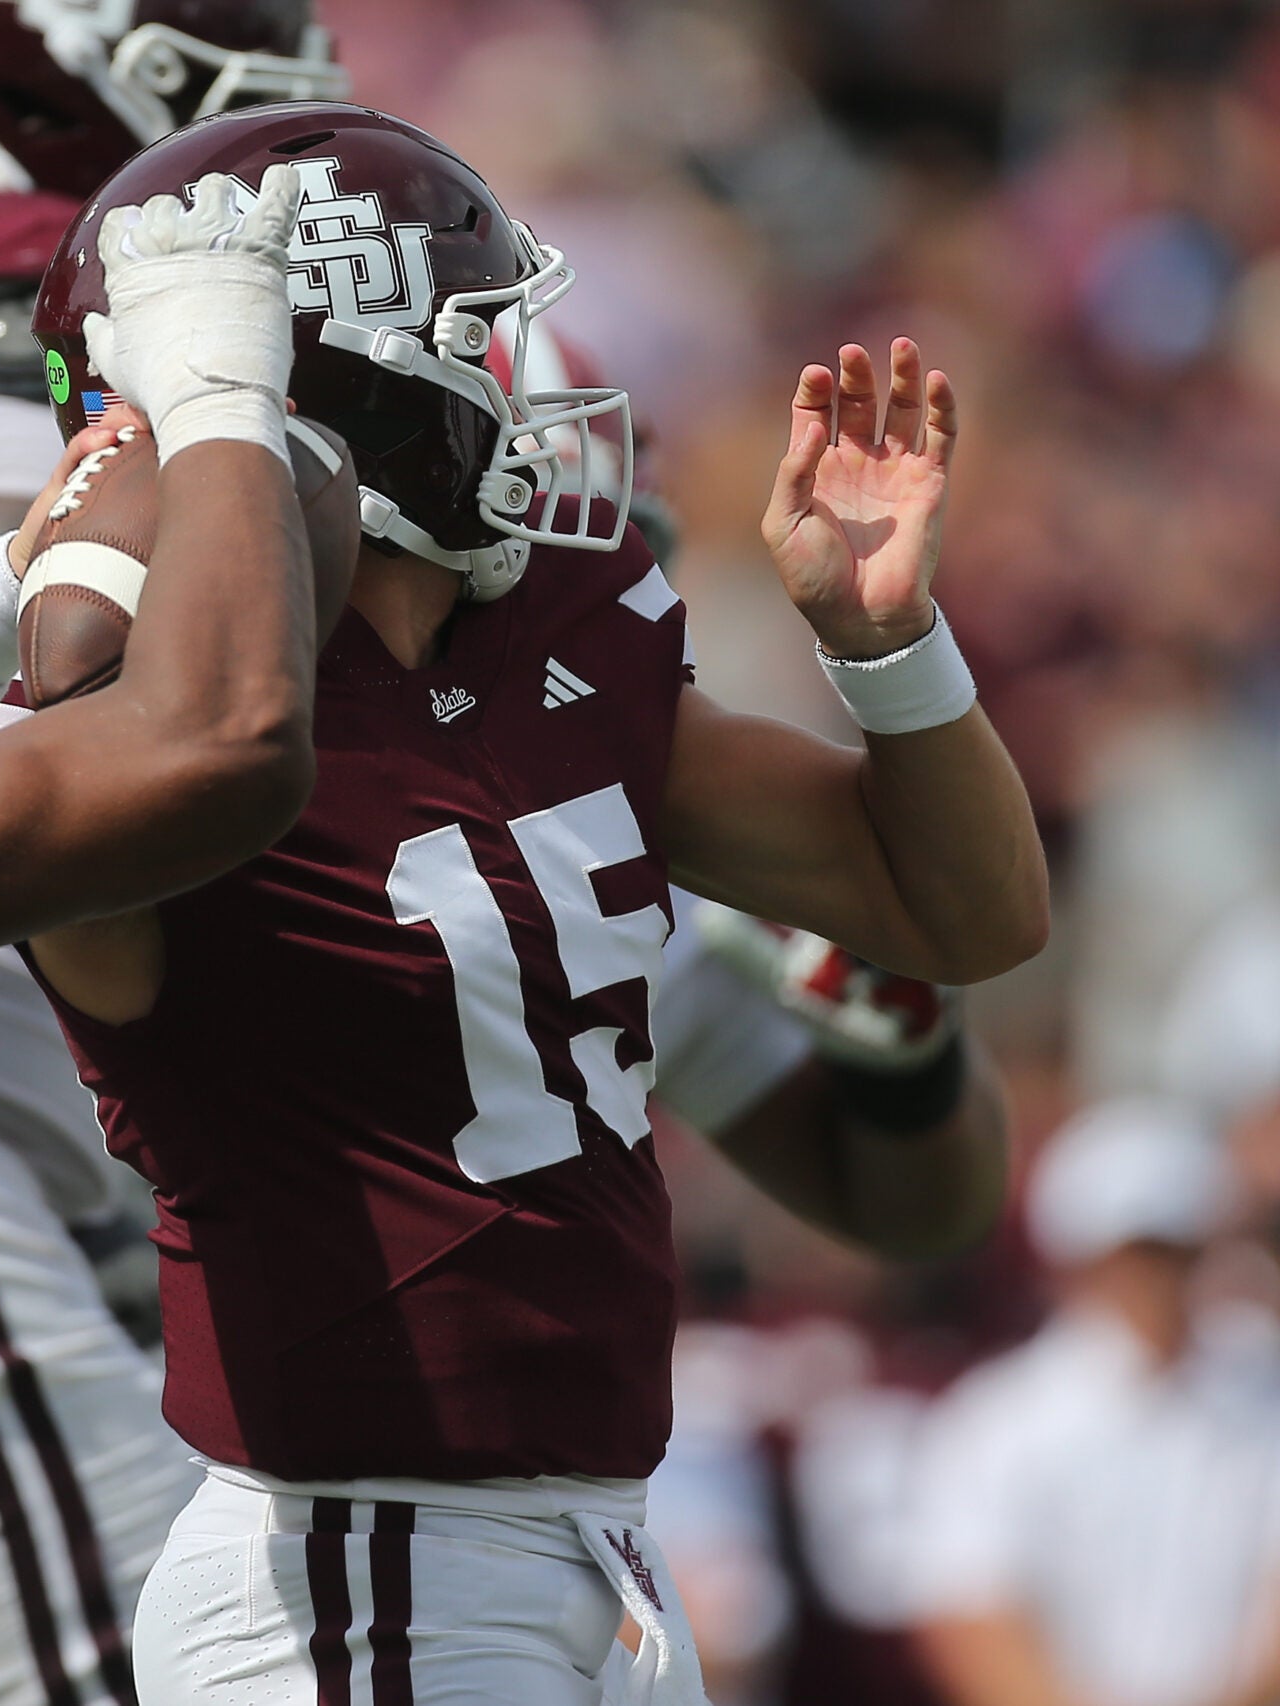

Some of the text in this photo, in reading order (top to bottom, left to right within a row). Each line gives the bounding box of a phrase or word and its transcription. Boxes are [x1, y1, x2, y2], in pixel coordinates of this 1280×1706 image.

[48, 366, 65, 385] C2P
[429, 686, 476, 723] State
[385, 783, 670, 1184] 15
